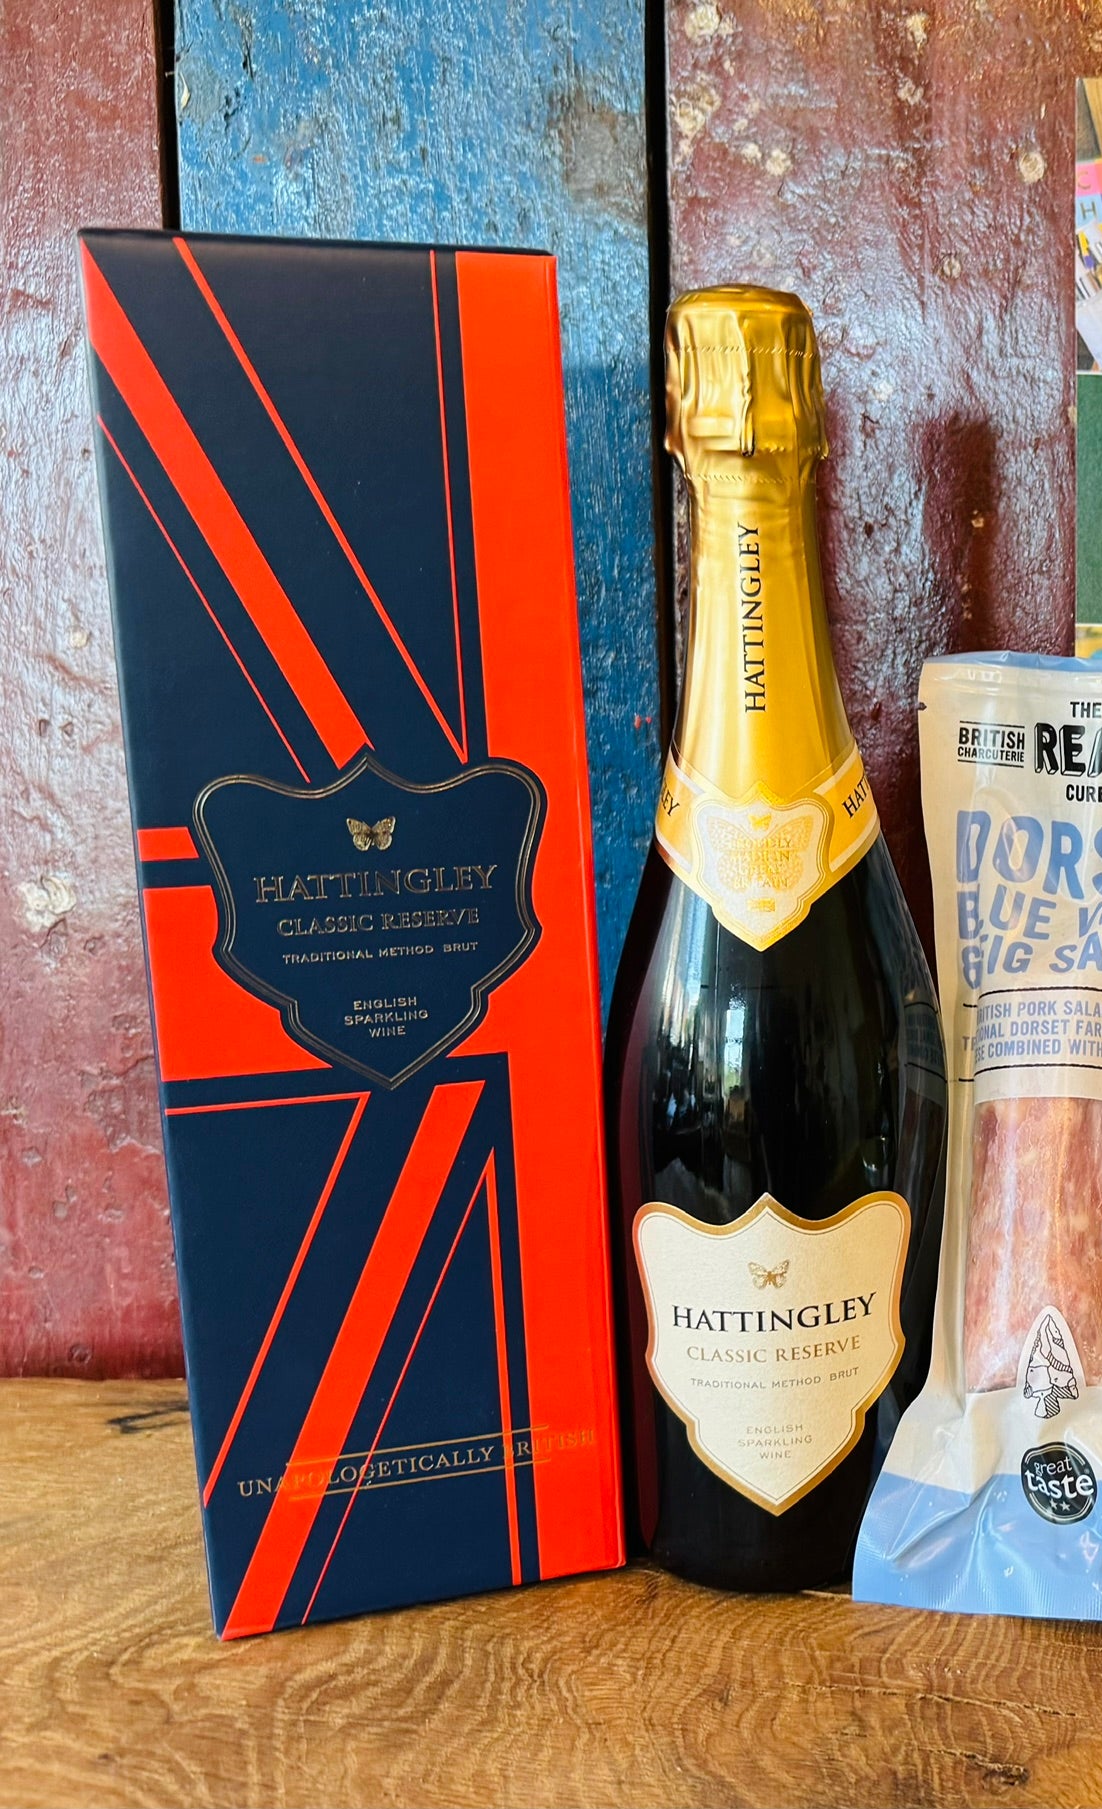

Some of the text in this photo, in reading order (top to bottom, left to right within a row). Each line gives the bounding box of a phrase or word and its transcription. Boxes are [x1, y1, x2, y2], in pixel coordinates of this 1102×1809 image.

[737, 521, 767, 714] HATTINGLEY
[1069, 701, 1102, 719] THE
[958, 727, 1025, 750] BRITISH
[957, 746, 1025, 763] CHARCUTERIE
[253, 864, 498, 903] HATTINGLEY
[276, 908, 480, 937] CLASSIC RESERVE
[282, 942, 479, 965] TRADITIONAL METHOD BRUT
[980, 933, 1034, 975] IG
[353, 996, 418, 1011] ENGLISH
[977, 1003, 1011, 1024] RITISH
[1017, 1000, 1057, 1017] PORK
[344, 1009, 429, 1026] SPARKLING
[1010, 1019, 1071, 1036] DORSET
[369, 1025, 407, 1039] WINE
[987, 1037, 1062, 1058] COMBINED
[672, 1291, 877, 1334] HATTINGLEY
[687, 1335, 861, 1363] CLASSIC RESERVE
[690, 1366, 860, 1390] TRADITIONAL METHOD BRUT
[746, 1423, 804, 1435] ENGLISH
[738, 1435, 813, 1448] SPARKLING
[759, 1450, 792, 1460] WINE
[1033, 1456, 1073, 1477] great
[237, 1445, 496, 1498] UNAPOLOGETICALLY
[1025, 1467, 1095, 1500] taste
